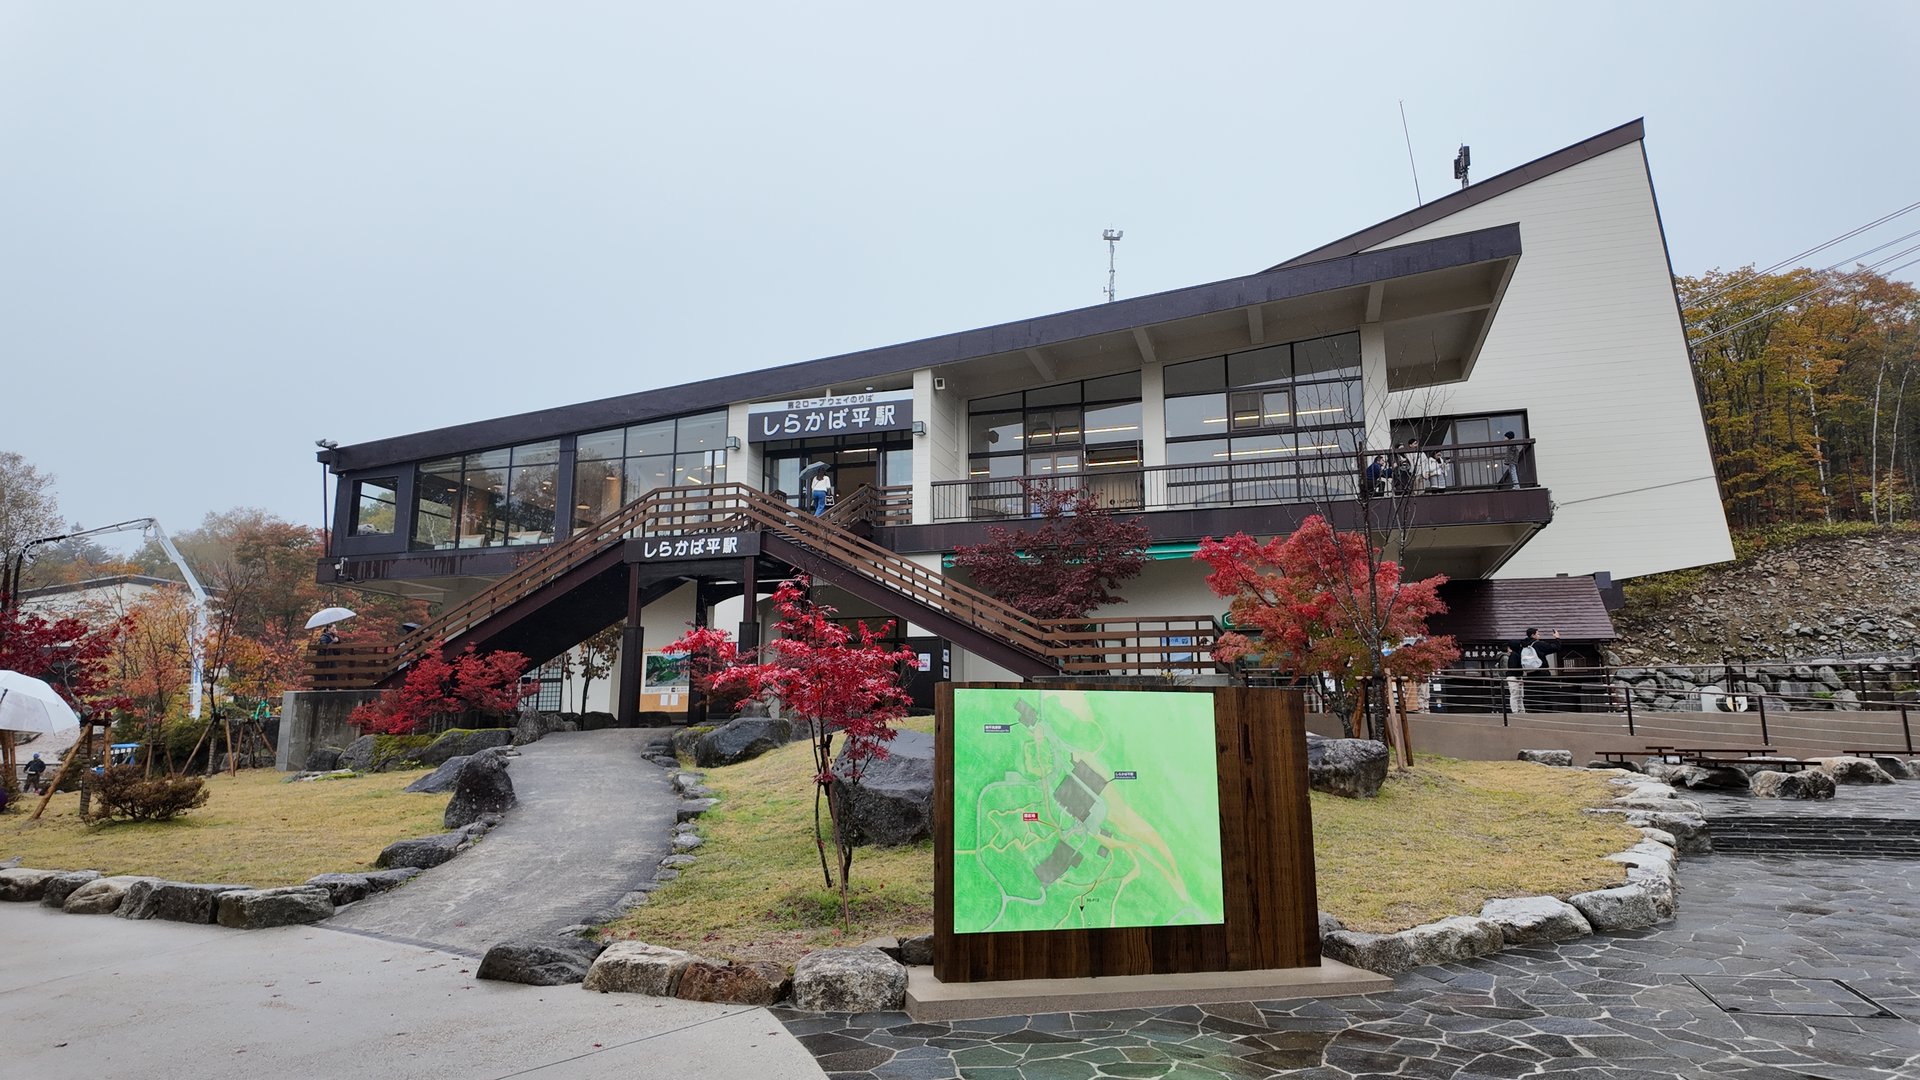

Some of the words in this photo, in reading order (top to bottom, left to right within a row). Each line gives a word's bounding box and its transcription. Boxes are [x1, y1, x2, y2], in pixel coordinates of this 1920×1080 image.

[763, 405, 895, 436] しらかば平駅
[643, 537, 738, 558] しらかば平駅
